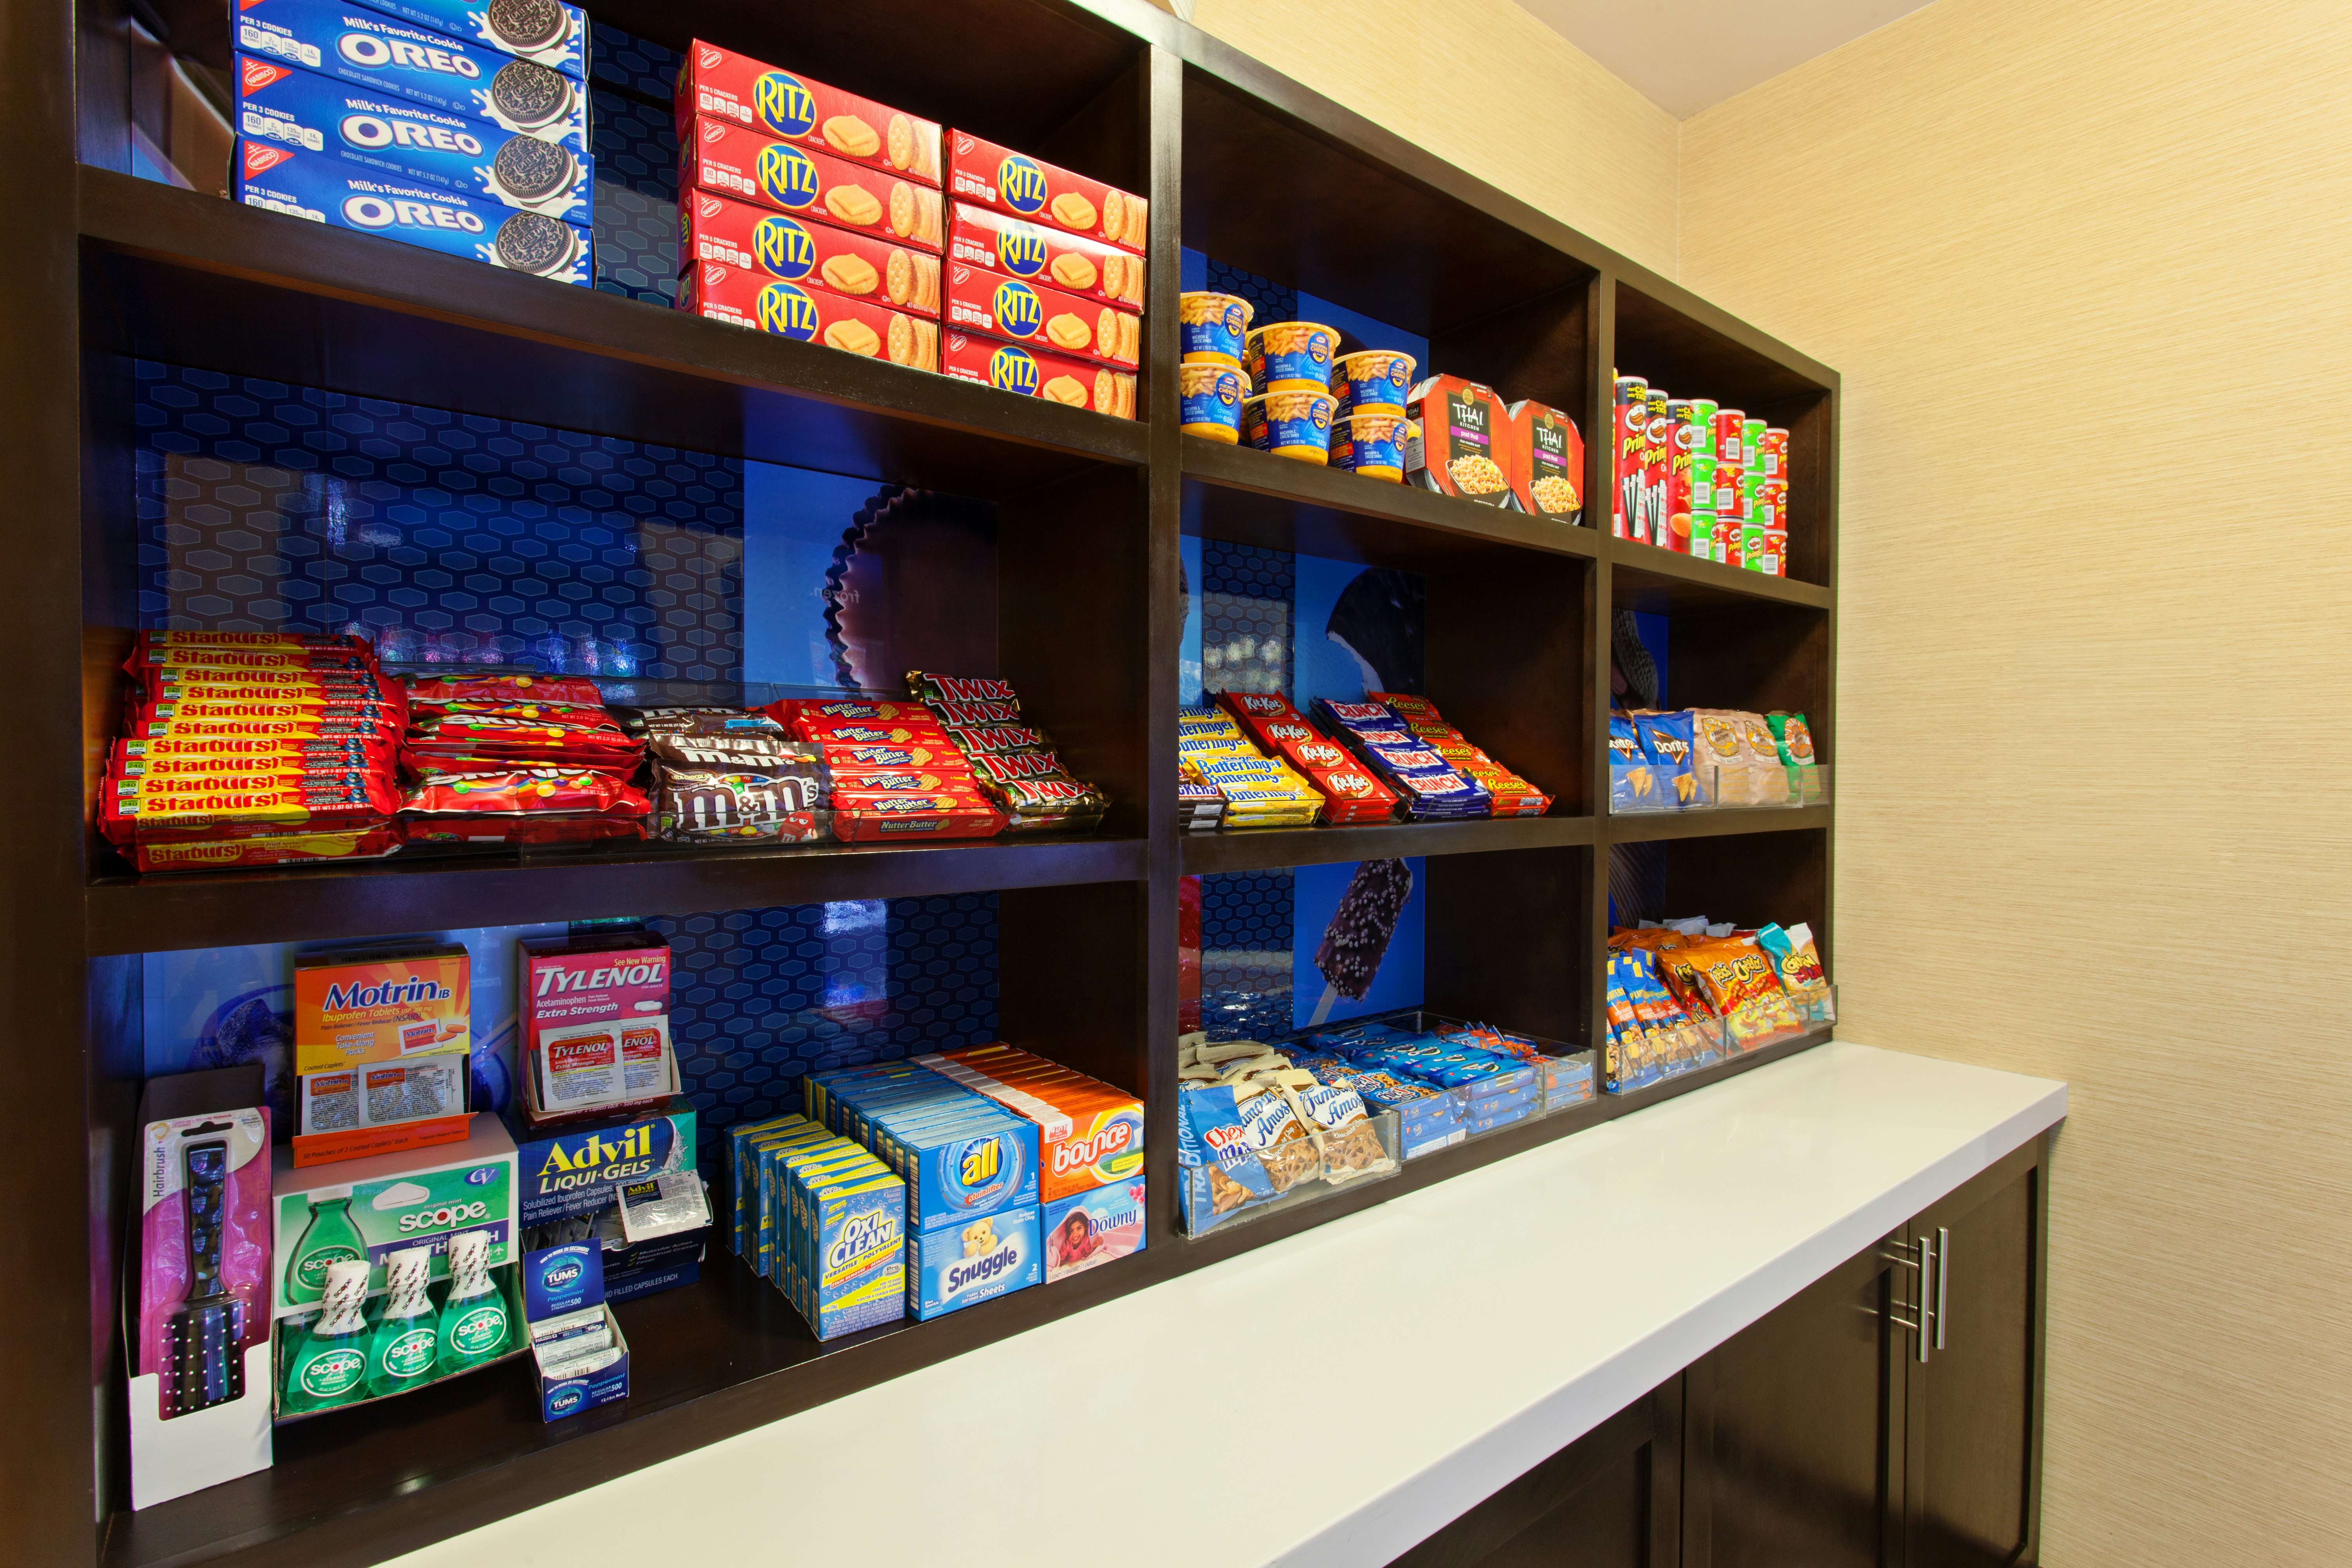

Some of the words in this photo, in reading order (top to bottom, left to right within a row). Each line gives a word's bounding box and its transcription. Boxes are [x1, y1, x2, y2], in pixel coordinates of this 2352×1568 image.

[241, 16, 254, 26] PER
[263, 22, 292, 37] COOKIES
[243, 28, 258, 38] 160
[343, 17, 380, 32] Milk's
[379, 23, 427, 43] Favorite
[427, 34, 464, 51] Cookie
[341, 33, 479, 78] OREO
[702, 54, 720, 67] NABISCO
[247, 66, 274, 85] NABISCO
[339, 67, 361, 79] CHOCOLATE
[362, 74, 382, 86] SANDWICH
[383, 80, 399, 91] COOKIES
[434, 96, 446, 106] (147g)
[714, 88, 738, 101] CRACKERS
[759, 75, 812, 122] RITZ
[343, 115, 482, 154] OREO
[808, 135, 825, 145] CRACKERS
[344, 197, 484, 232] OREO
[762, 287, 814, 332] RITZ
[994, 351, 1036, 390] RITZ
[1218, 407, 1233, 416] cheesy
[1223, 415, 1236, 426] easy
[1453, 403, 1483, 425] THAI
[1460, 421, 1479, 431] KITCHEN
[1537, 426, 1562, 448] THAI
[172, 632, 282, 646] Starburst
[924, 674, 1015, 701] TWIX
[820, 702, 854, 716] Nutter
[841, 705, 872, 718] Butter
[174, 721, 293, 735] Starburst
[1654, 740, 1689, 754] Doritos
[998, 780, 1095, 802] TWIX
[1408, 774, 1463, 792] CRUNCH
[147, 793, 279, 812] Starburst
[673, 782, 818, 831] m&m's
[882, 821, 907, 830] Nutter
[908, 820, 937, 830] Butter
[535, 964, 663, 997] TYLENOL
[324, 976, 438, 1011] Motrin
[438, 989, 449, 999] IB
[537, 996, 586, 1007] Acetaminophen
[322, 1009, 366, 1022] Ibuprofen
[368, 1007, 399, 1017] Tablets
[393, 1013, 421, 1022] (NSAID)
[537, 1009, 566, 1018] Extra
[570, 1003, 618, 1015] Strength
[1619, 1011, 1635, 1021] PEANUTS
[336, 1032, 374, 1042] Convenient
[336, 1039, 374, 1049] Take-Along
[1517, 1071, 1532, 1079] OREO
[1241, 1091, 1277, 1127] amous
[1327, 1097, 1363, 1125] Amos
[1207, 1125, 1245, 1147] Chex
[1334, 1126, 1356, 1139] Chocolate
[537, 1125, 651, 1176] Advil
[1054, 1123, 1129, 1174] bounce
[962, 1137, 1000, 1186] all
[153, 1147, 166, 1197] Hairbrush
[471, 1168, 495, 1185] CV
[523, 1196, 555, 1210] Solubilized
[557, 1191, 585, 1203] Ibuprofen
[587, 1185, 613, 1198] Capsules,
[969, 1182, 1003, 1201] stainlifter
[424, 1201, 447, 1209] original
[524, 1211, 537, 1221] Pain
[539, 1203, 582, 1217] Reliever/Fever
[584, 1196, 607, 1207] Reducer
[399, 1201, 486, 1232] scope
[1089, 1209, 1136, 1236] Downy
[844, 1212, 882, 1245] OXI
[413, 1235, 448, 1246] ORIGINAL
[831, 1223, 892, 1267] CLEAN
[825, 1260, 857, 1279] VERSATILE
[864, 1237, 901, 1260] POLYVALENT
[548, 1269, 578, 1283] TUMS
[831, 1279, 845, 1288] STAIN
[846, 1267, 866, 1281] REMOVER
[871, 1252, 894, 1268] DETACHANT
[948, 1246, 1016, 1292] Snuggle
[548, 1289, 584, 1301] Peppermint
[614, 1285, 633, 1298] FILLED
[634, 1278, 662, 1292] CAPSULES
[664, 1274, 677, 1284] EACH
[979, 1283, 1005, 1298] Sheets
[551, 1299, 570, 1308] REGULAR
[962, 1295, 978, 1303] SOFTENER
[458, 1315, 500, 1336] scope
[310, 1357, 360, 1375] scope
[554, 1396, 577, 1408] TUMS
